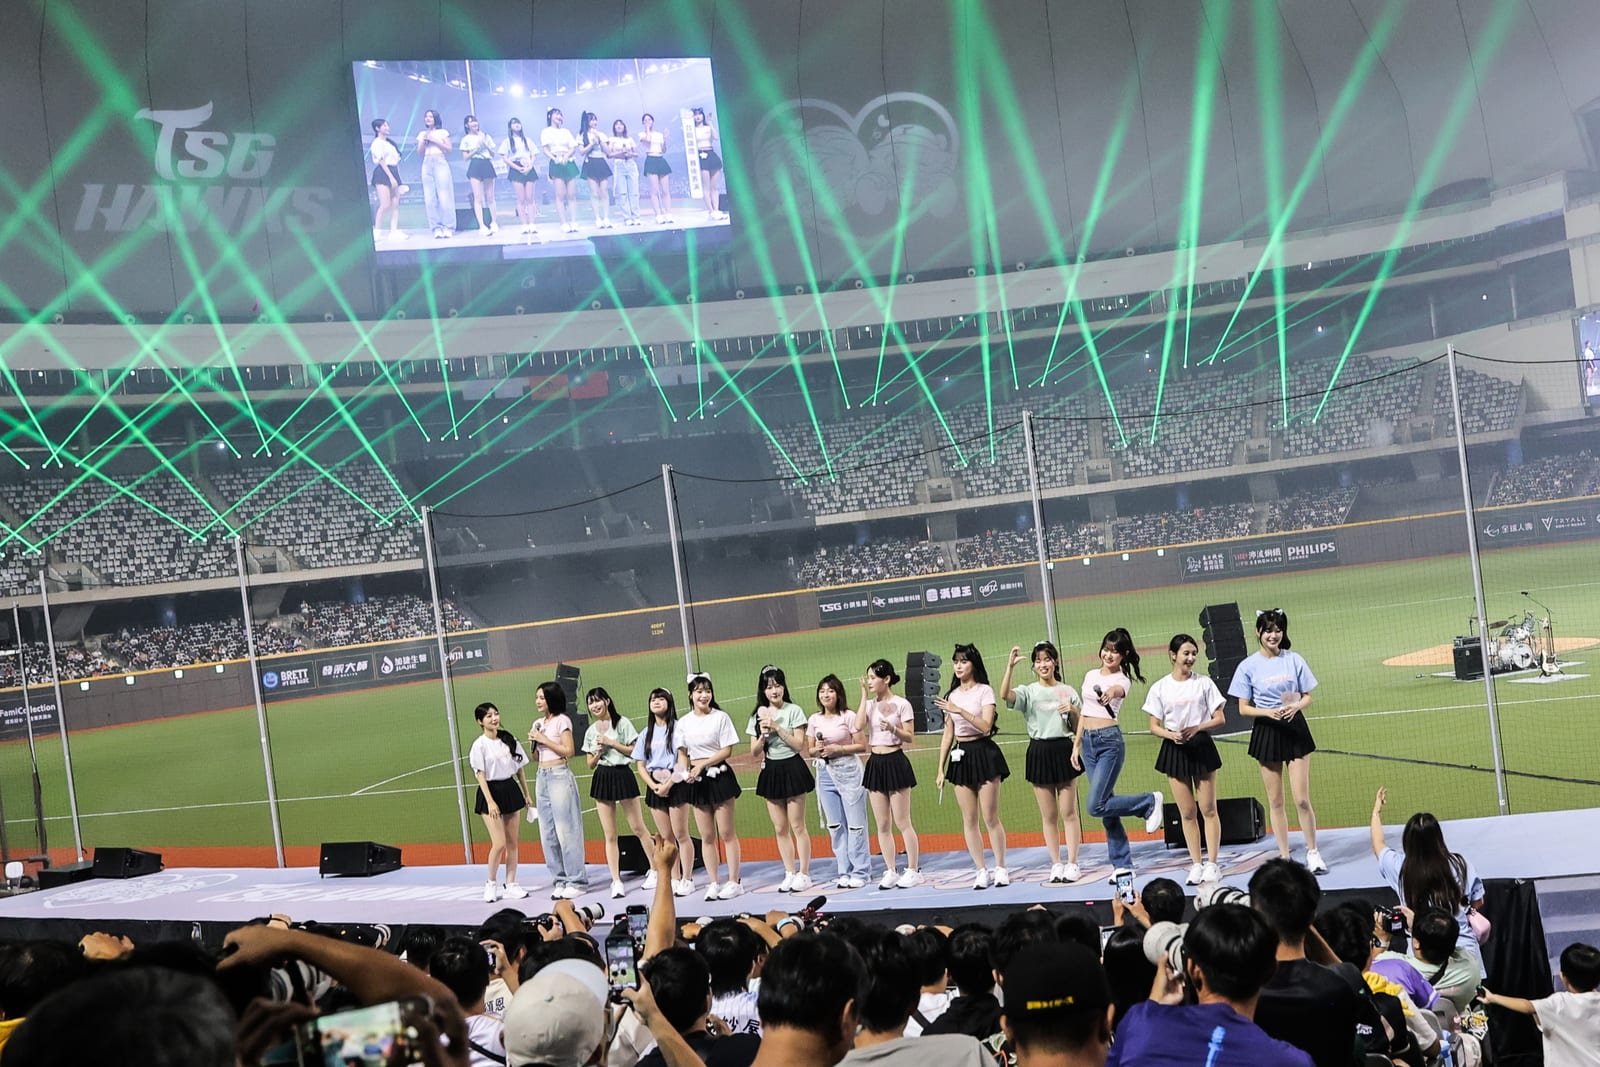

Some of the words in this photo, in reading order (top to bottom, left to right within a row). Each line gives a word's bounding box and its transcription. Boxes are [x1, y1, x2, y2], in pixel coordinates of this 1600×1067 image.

[134, 100, 276, 181] TSG
[74, 183, 332, 232] HAWKS
[1287, 542, 1335, 556] PHILIPS
[819, 602, 842, 612] TSG
[280, 668, 308, 681] BRETT
